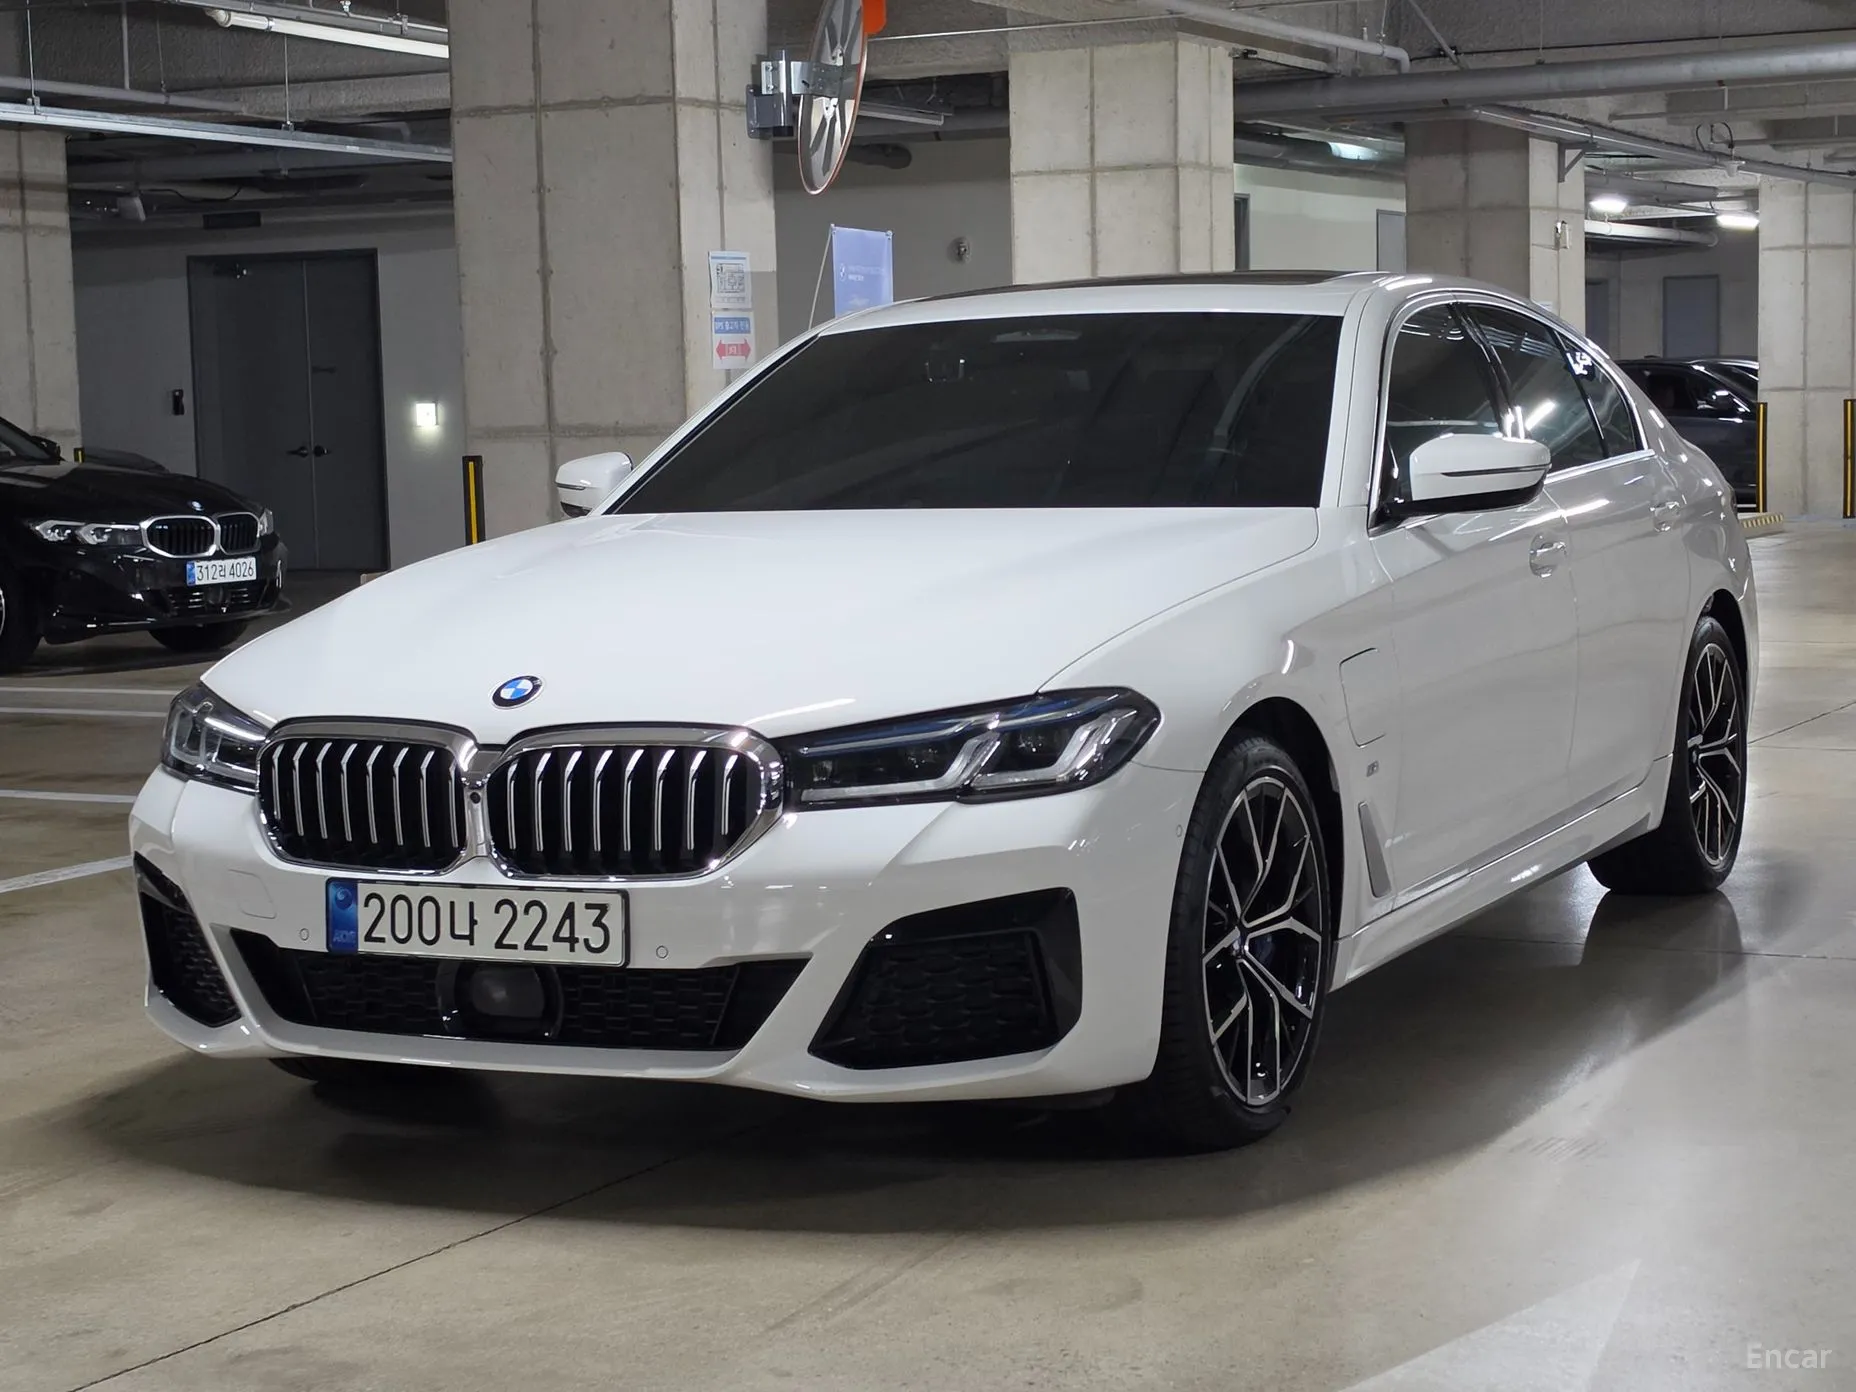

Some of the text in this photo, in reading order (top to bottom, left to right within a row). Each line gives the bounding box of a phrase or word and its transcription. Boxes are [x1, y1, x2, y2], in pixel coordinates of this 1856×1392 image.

[229, 561, 254, 579] 4026
[363, 892, 611, 954] 200나 2243
